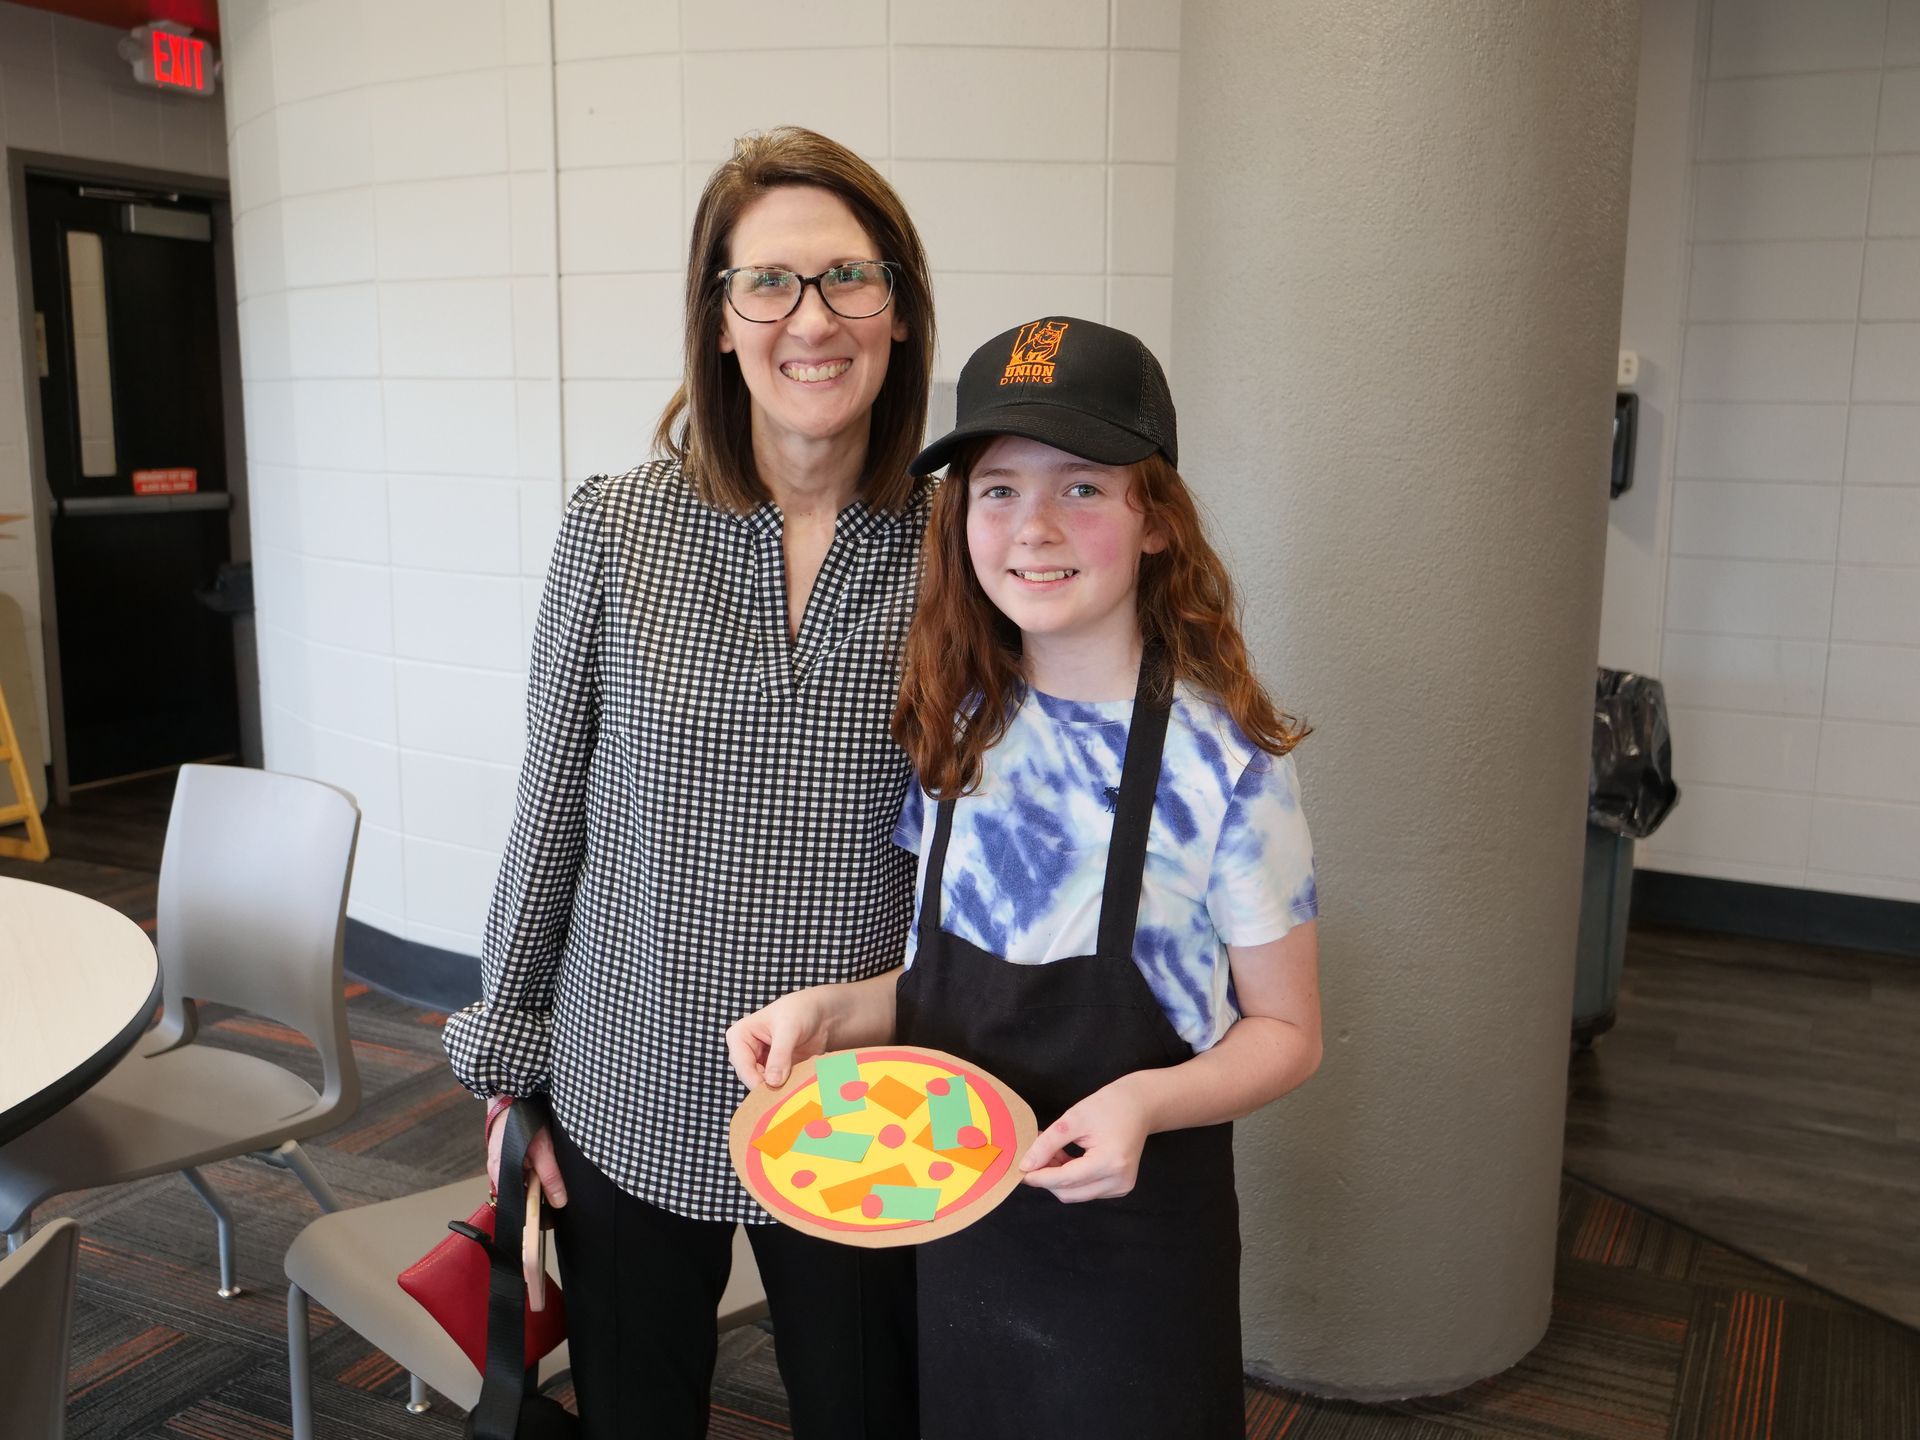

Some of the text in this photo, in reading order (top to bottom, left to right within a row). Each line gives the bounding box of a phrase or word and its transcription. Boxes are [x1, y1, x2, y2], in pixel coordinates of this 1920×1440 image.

[152, 30, 204, 90] EXIT
[1005, 365, 1055, 377] UNION
[1000, 376, 1053, 386] DINING
